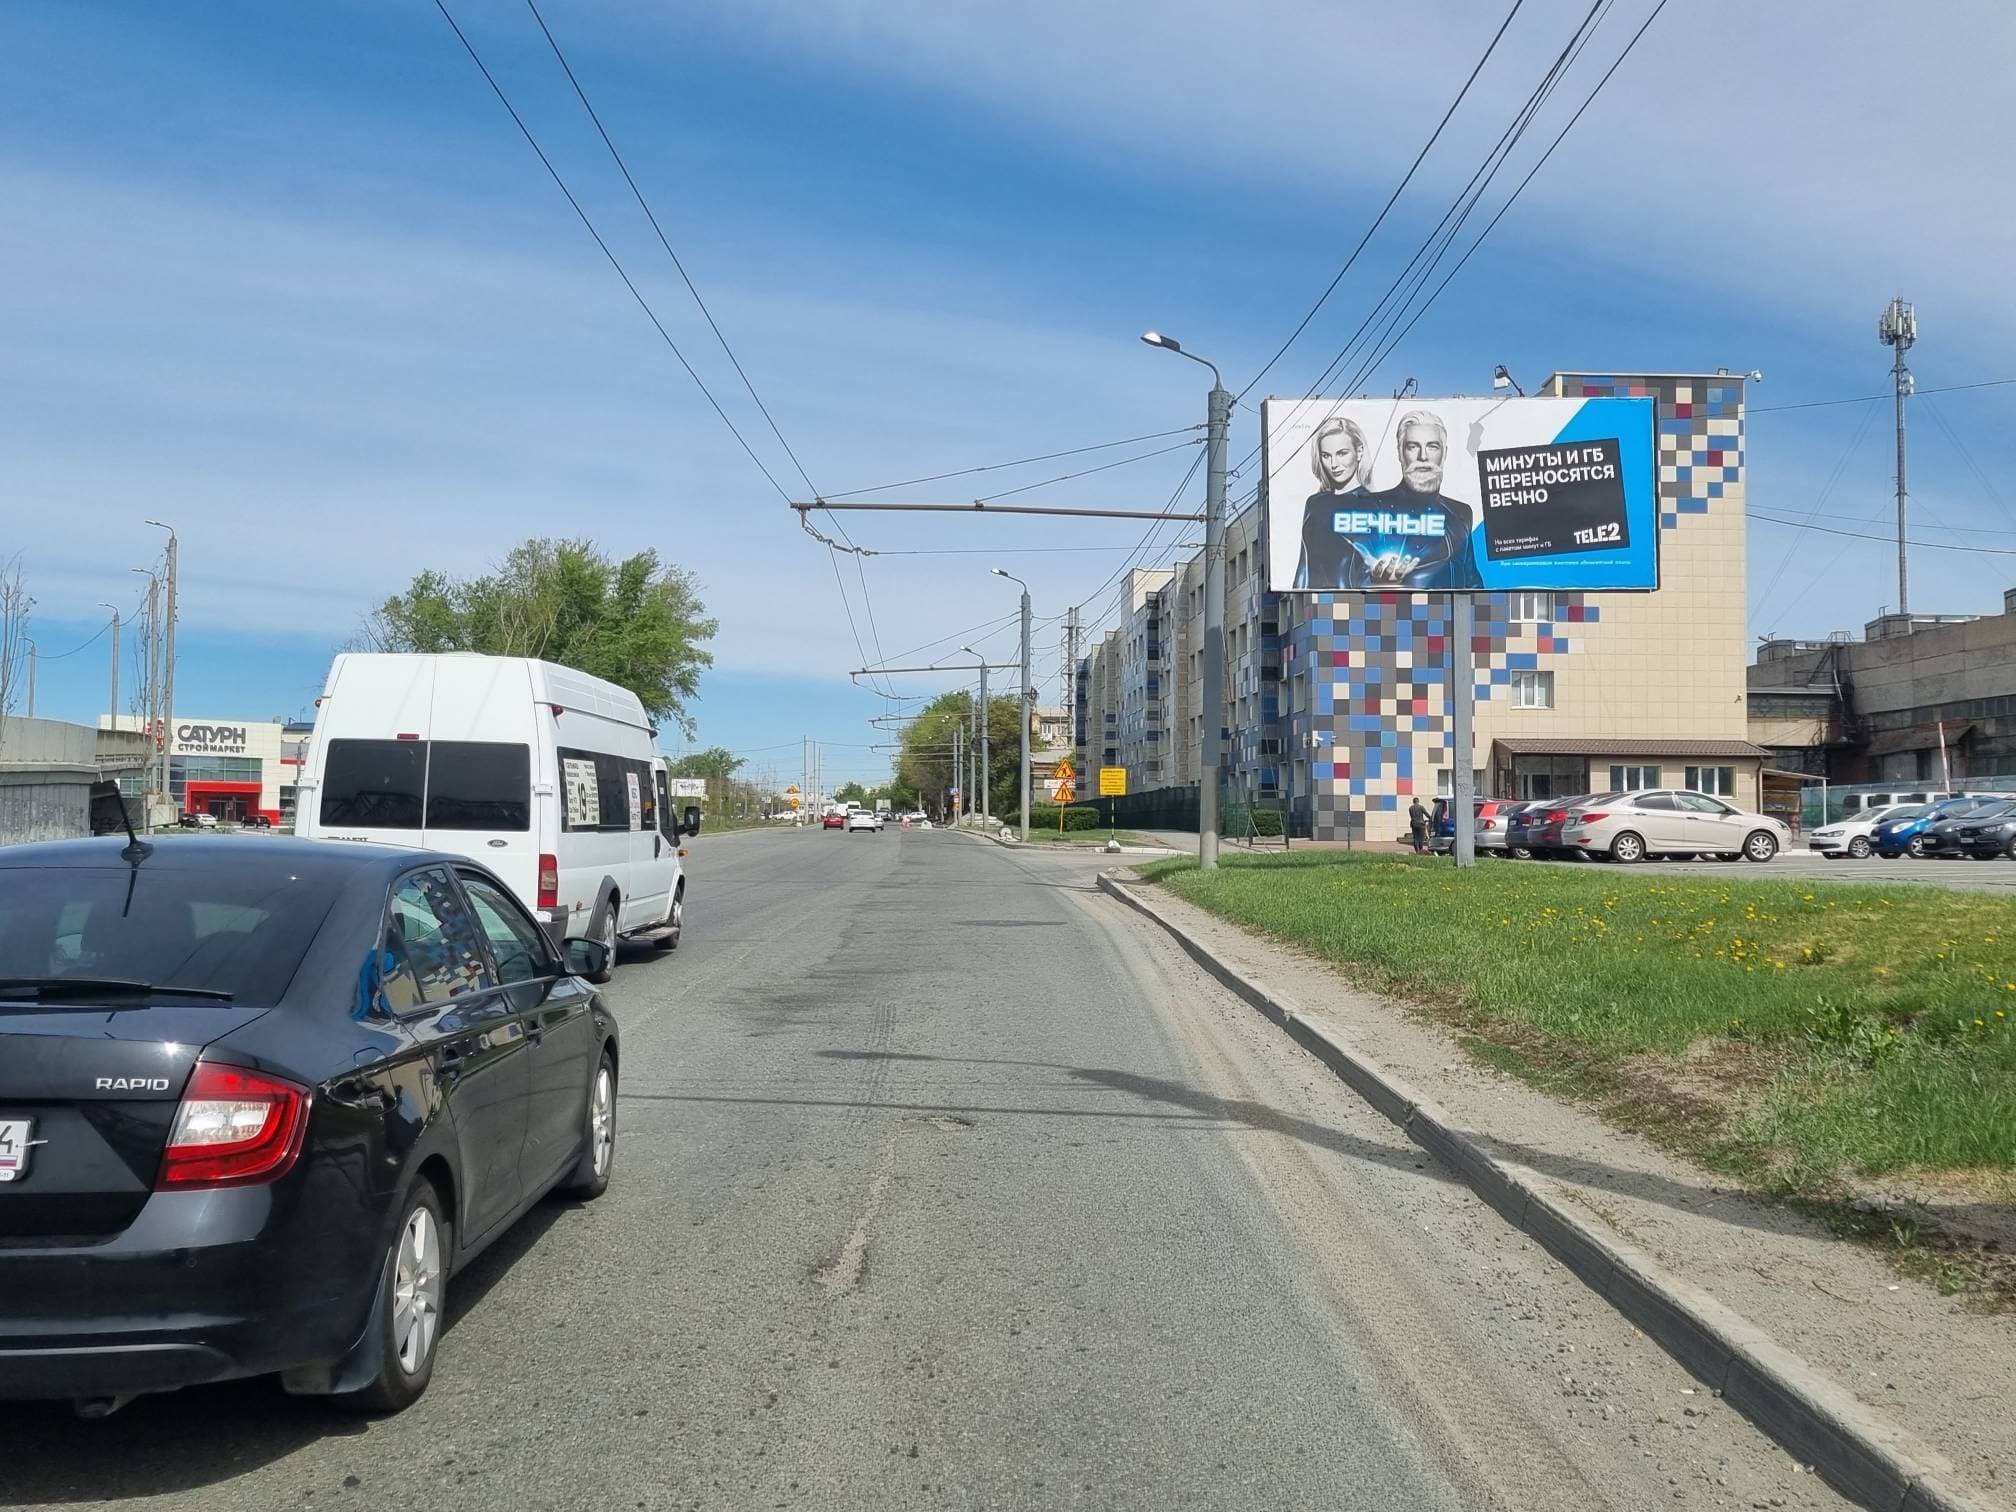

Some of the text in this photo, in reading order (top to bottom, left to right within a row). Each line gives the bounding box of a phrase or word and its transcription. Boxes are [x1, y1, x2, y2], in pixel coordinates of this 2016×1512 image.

[1486, 448, 1604, 472] МИНУТЫ И ГБ
[1487, 465, 1615, 490] ПЕРЕНОСЯТСЯ
[1489, 489, 1548, 508] ВЕЧНО
[1334, 513, 1446, 536] ВЕЧНЫЕ
[1574, 523, 1621, 545] TELE2
[178, 725, 246, 744] САТУРН
[178, 743, 246, 753] СТРОЙМАРКЕТ
[577, 782, 587, 821] 19
[96, 1078, 169, 1091] RAPID
